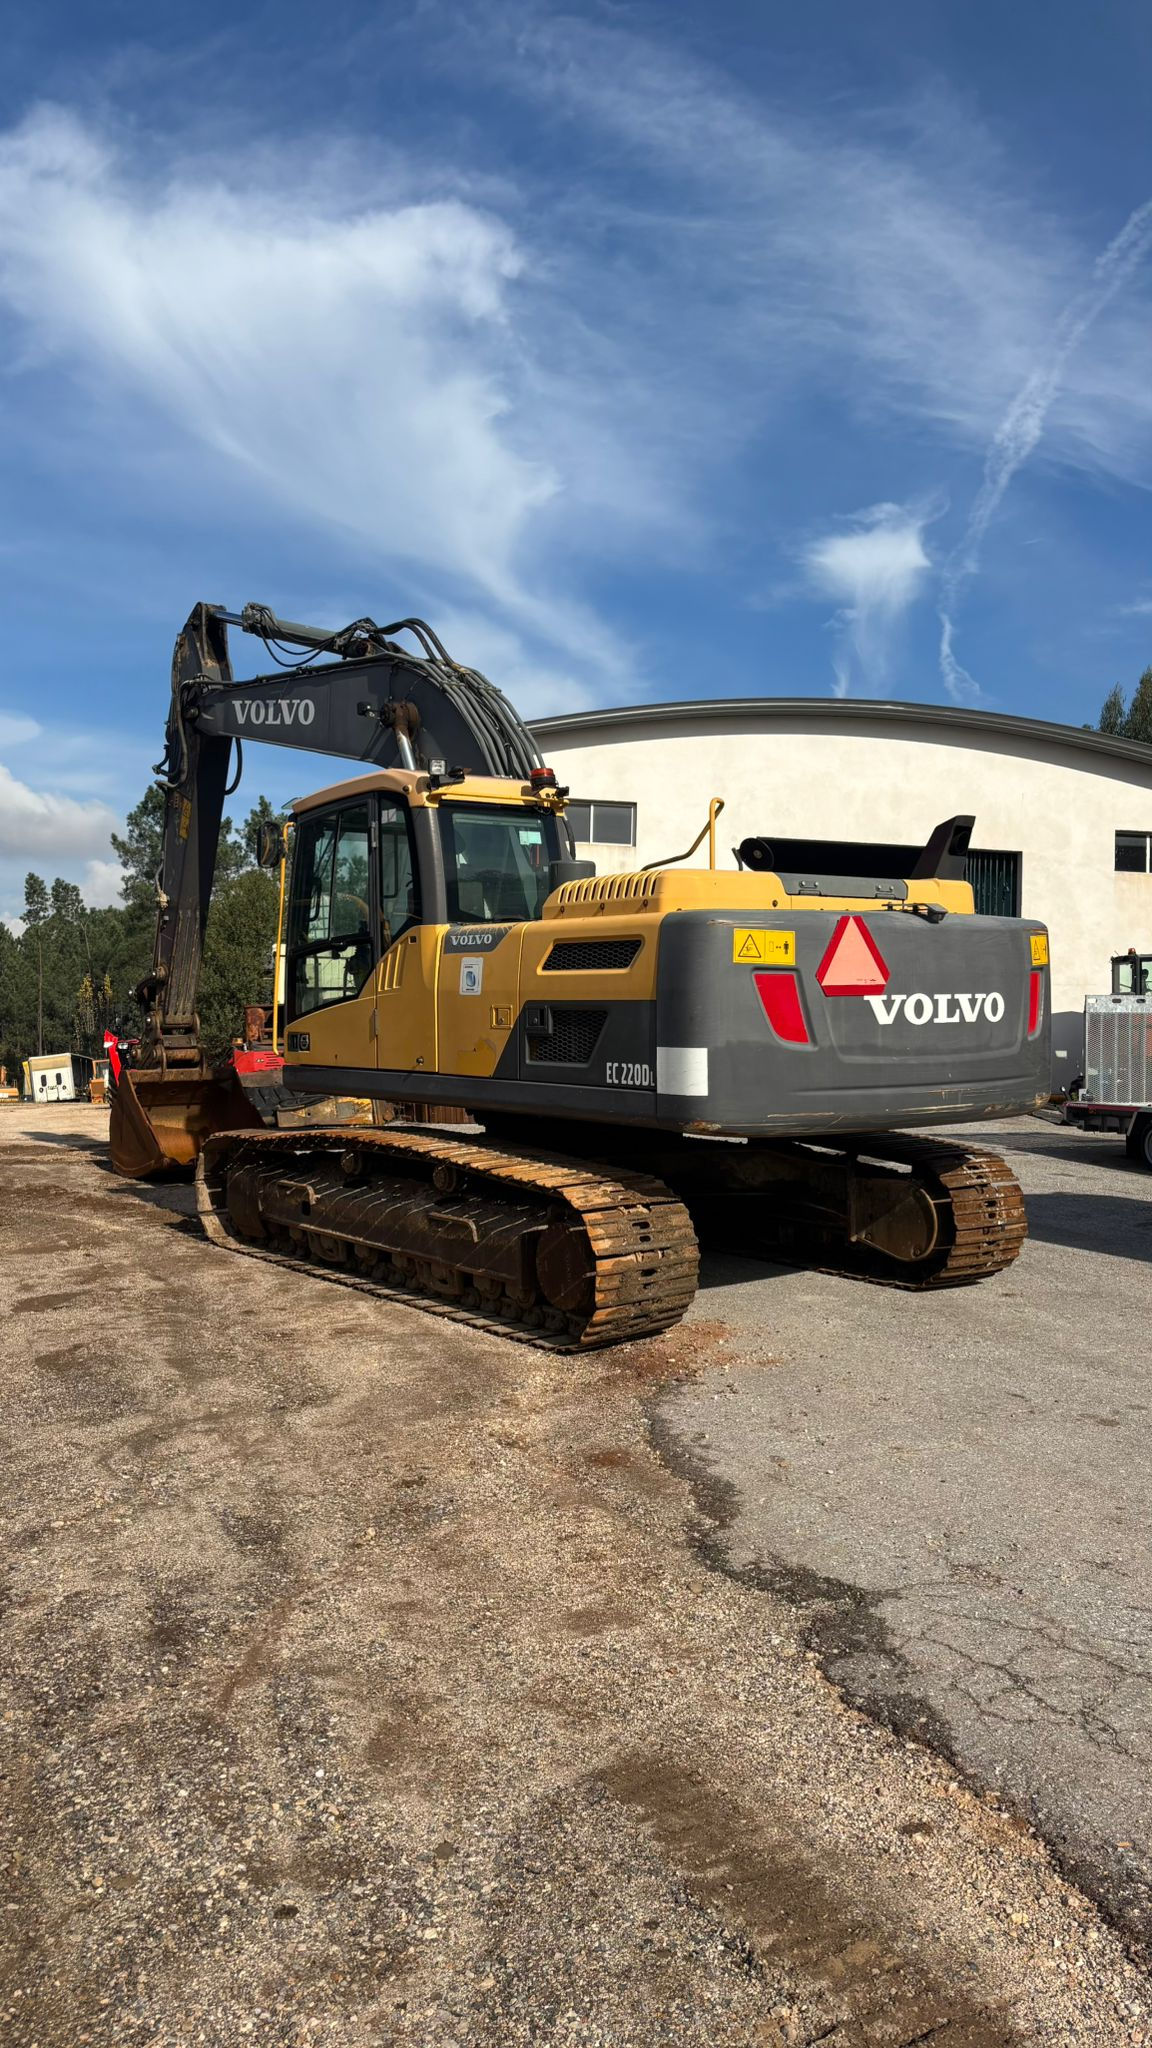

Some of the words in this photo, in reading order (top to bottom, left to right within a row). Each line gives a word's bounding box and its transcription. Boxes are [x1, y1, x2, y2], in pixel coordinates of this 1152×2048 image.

[231, 699, 315, 725] VOLVO
[450, 934, 492, 946] VOLVO
[863, 992, 1005, 1025] VOLVO
